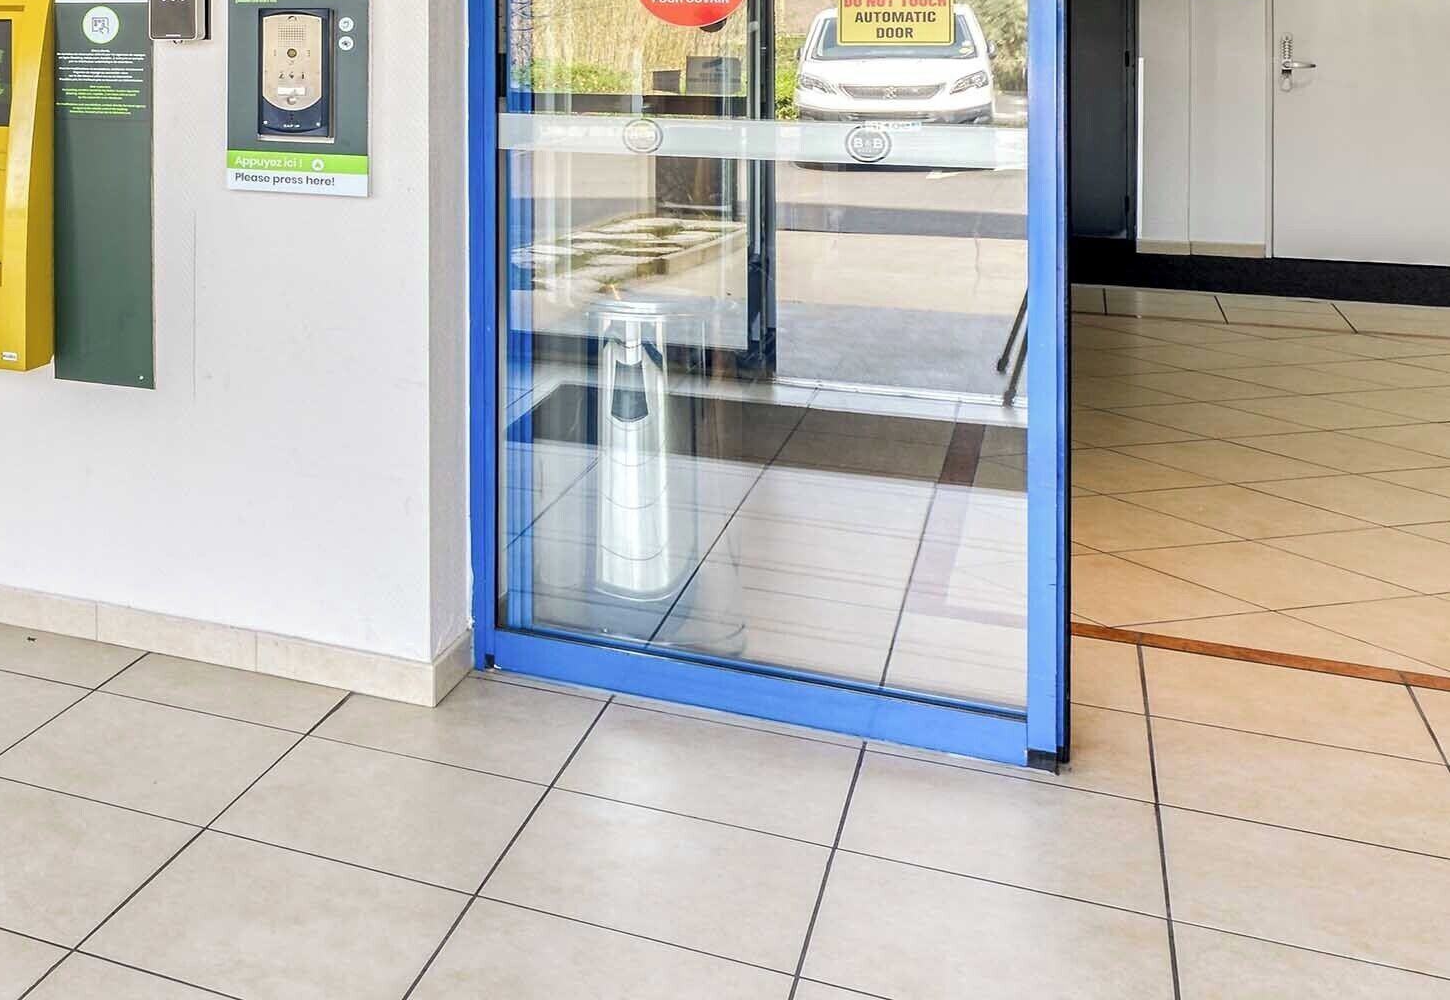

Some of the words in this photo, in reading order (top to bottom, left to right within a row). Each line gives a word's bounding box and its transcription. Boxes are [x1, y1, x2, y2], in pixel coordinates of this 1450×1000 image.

[855, 11, 937, 23] AUTOMATIC
[876, 27, 914, 39] DOOR
[235, 156, 282, 168] Appuyez
[283, 158, 297, 168] ici
[235, 172, 271, 183] Please
[272, 175, 303, 186] press
[305, 175, 335, 187] here!
